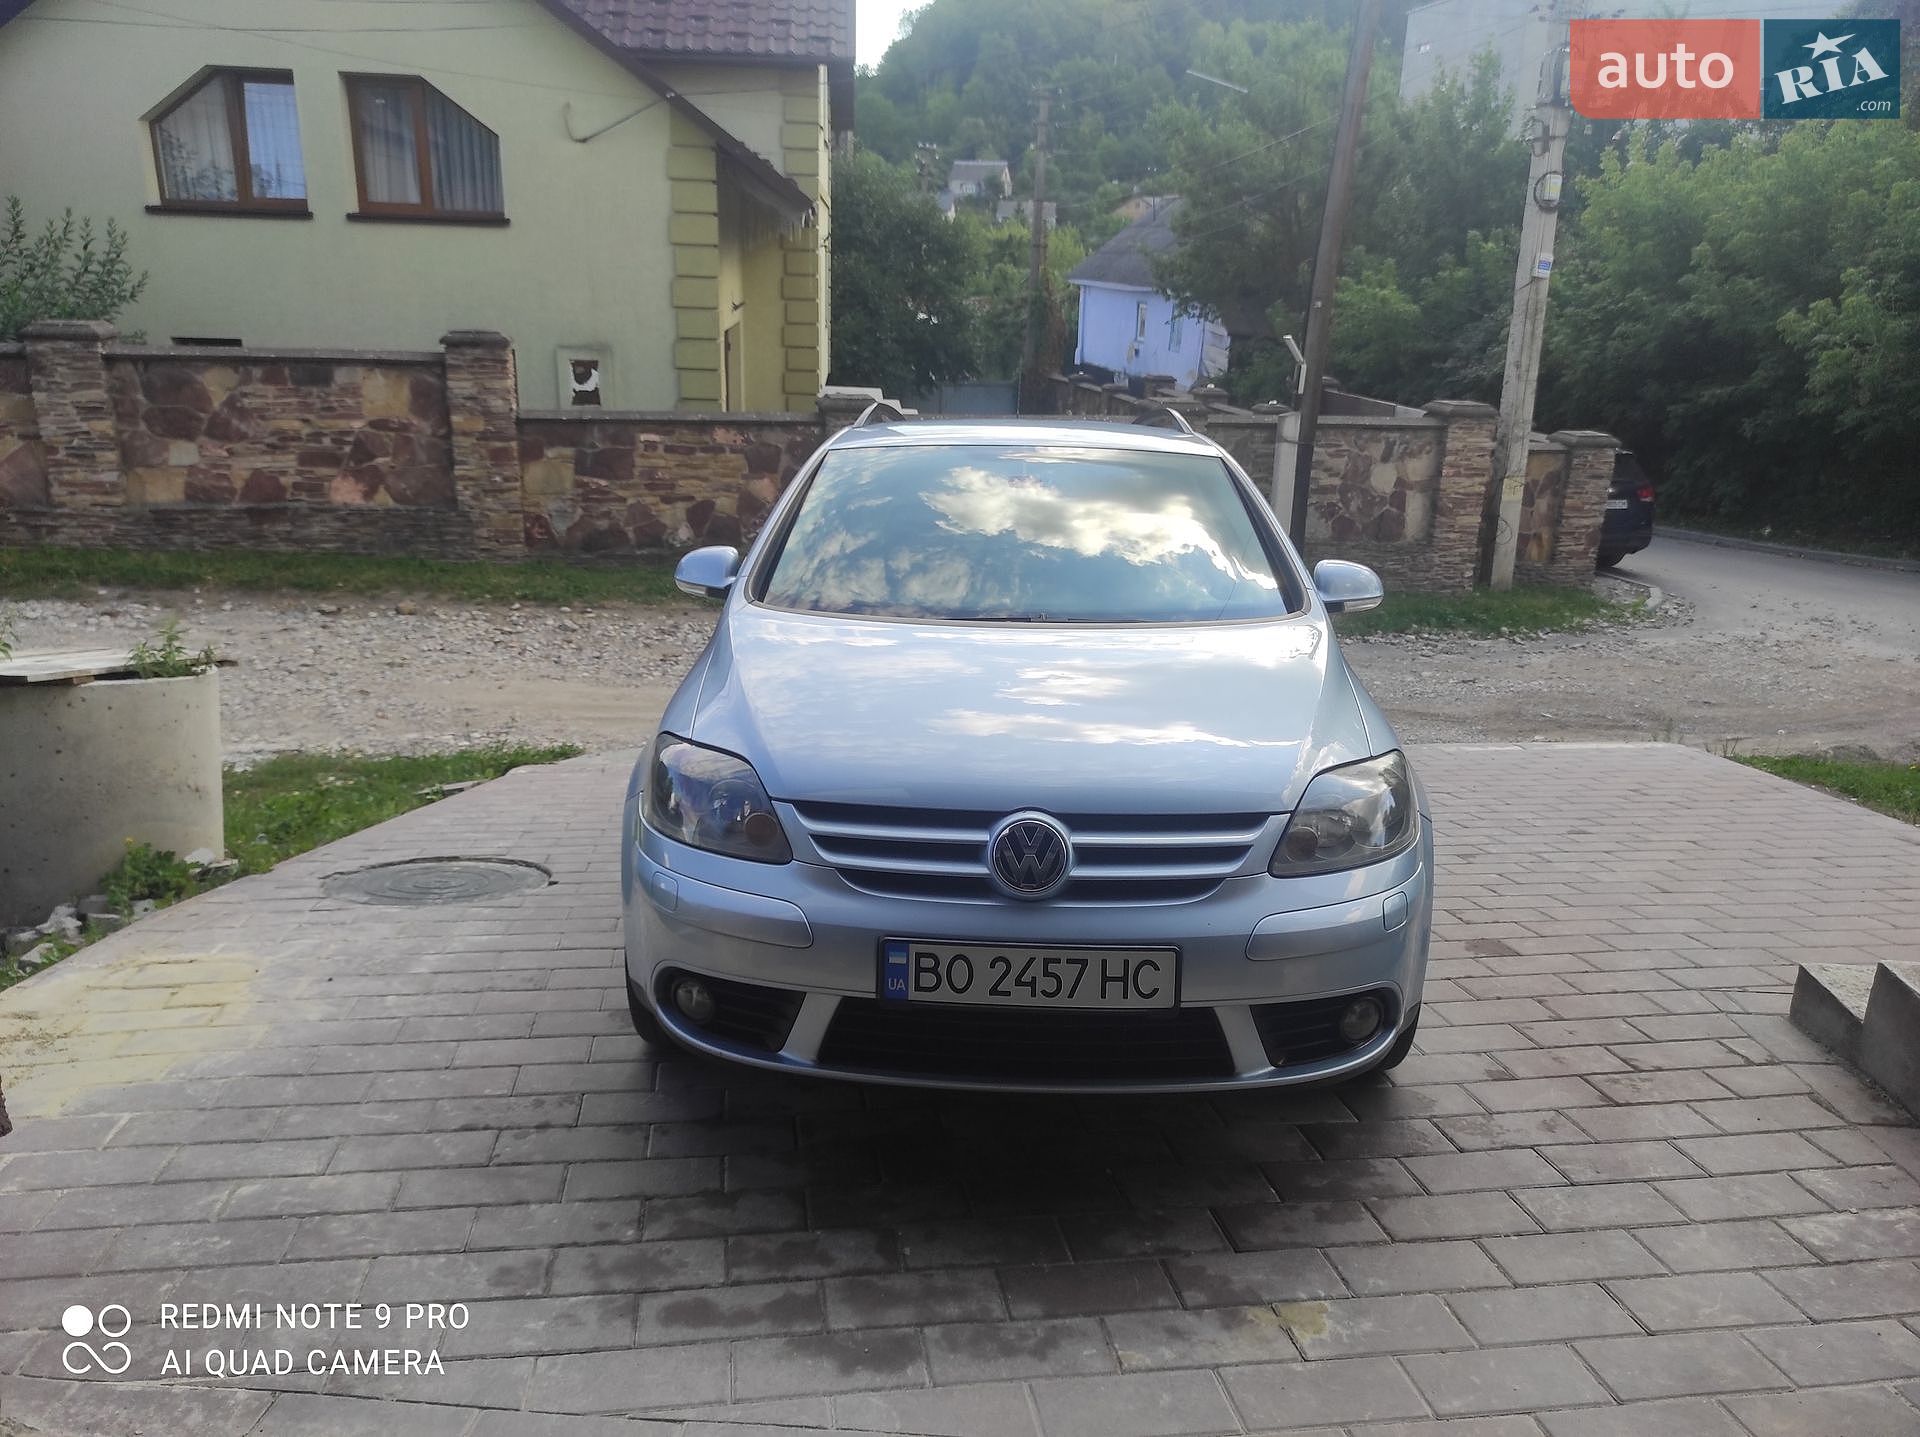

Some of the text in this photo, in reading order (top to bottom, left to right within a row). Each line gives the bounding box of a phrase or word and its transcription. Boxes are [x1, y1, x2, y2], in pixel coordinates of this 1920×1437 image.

[888, 978, 905, 991] UA
[988, 956, 1090, 999] 2457
[1100, 958, 1161, 1000] HC
